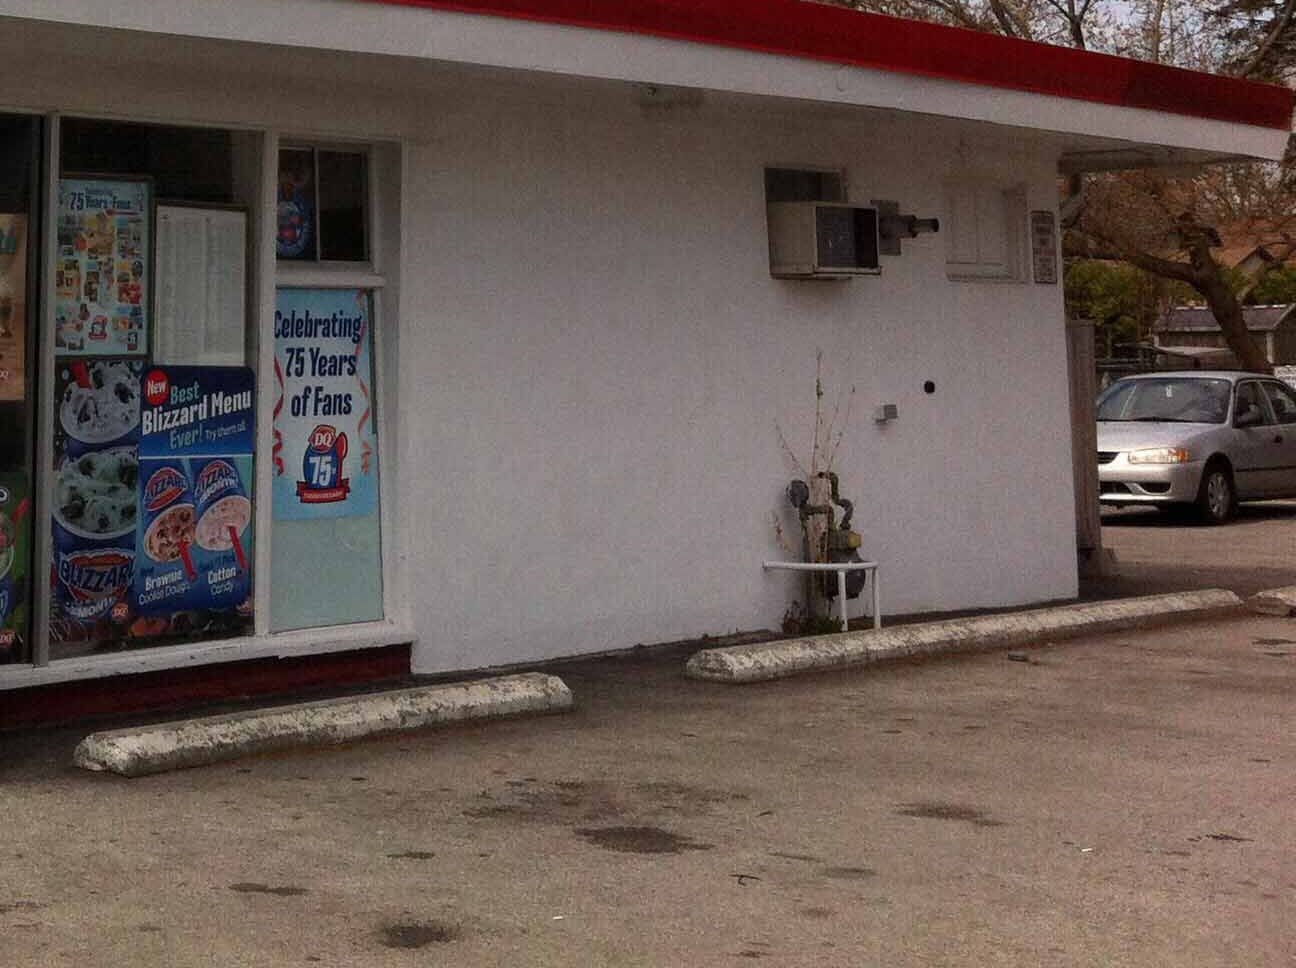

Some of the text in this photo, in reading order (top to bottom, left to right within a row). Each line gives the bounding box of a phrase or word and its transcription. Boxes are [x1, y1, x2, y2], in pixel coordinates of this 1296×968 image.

[273, 310, 362, 344] Celebrating
[285, 347, 357, 377] 75 Years
[170, 380, 200, 405] Best
[291, 386, 352, 417] of Fans
[142, 391, 252, 436] Blizzard Menu
[169, 422, 204, 450] Ever!
[314, 432, 334, 447] DQ
[309, 456, 332, 486] 75
[145, 569, 183, 592] Brownie
[207, 567, 237, 585] Cotton
